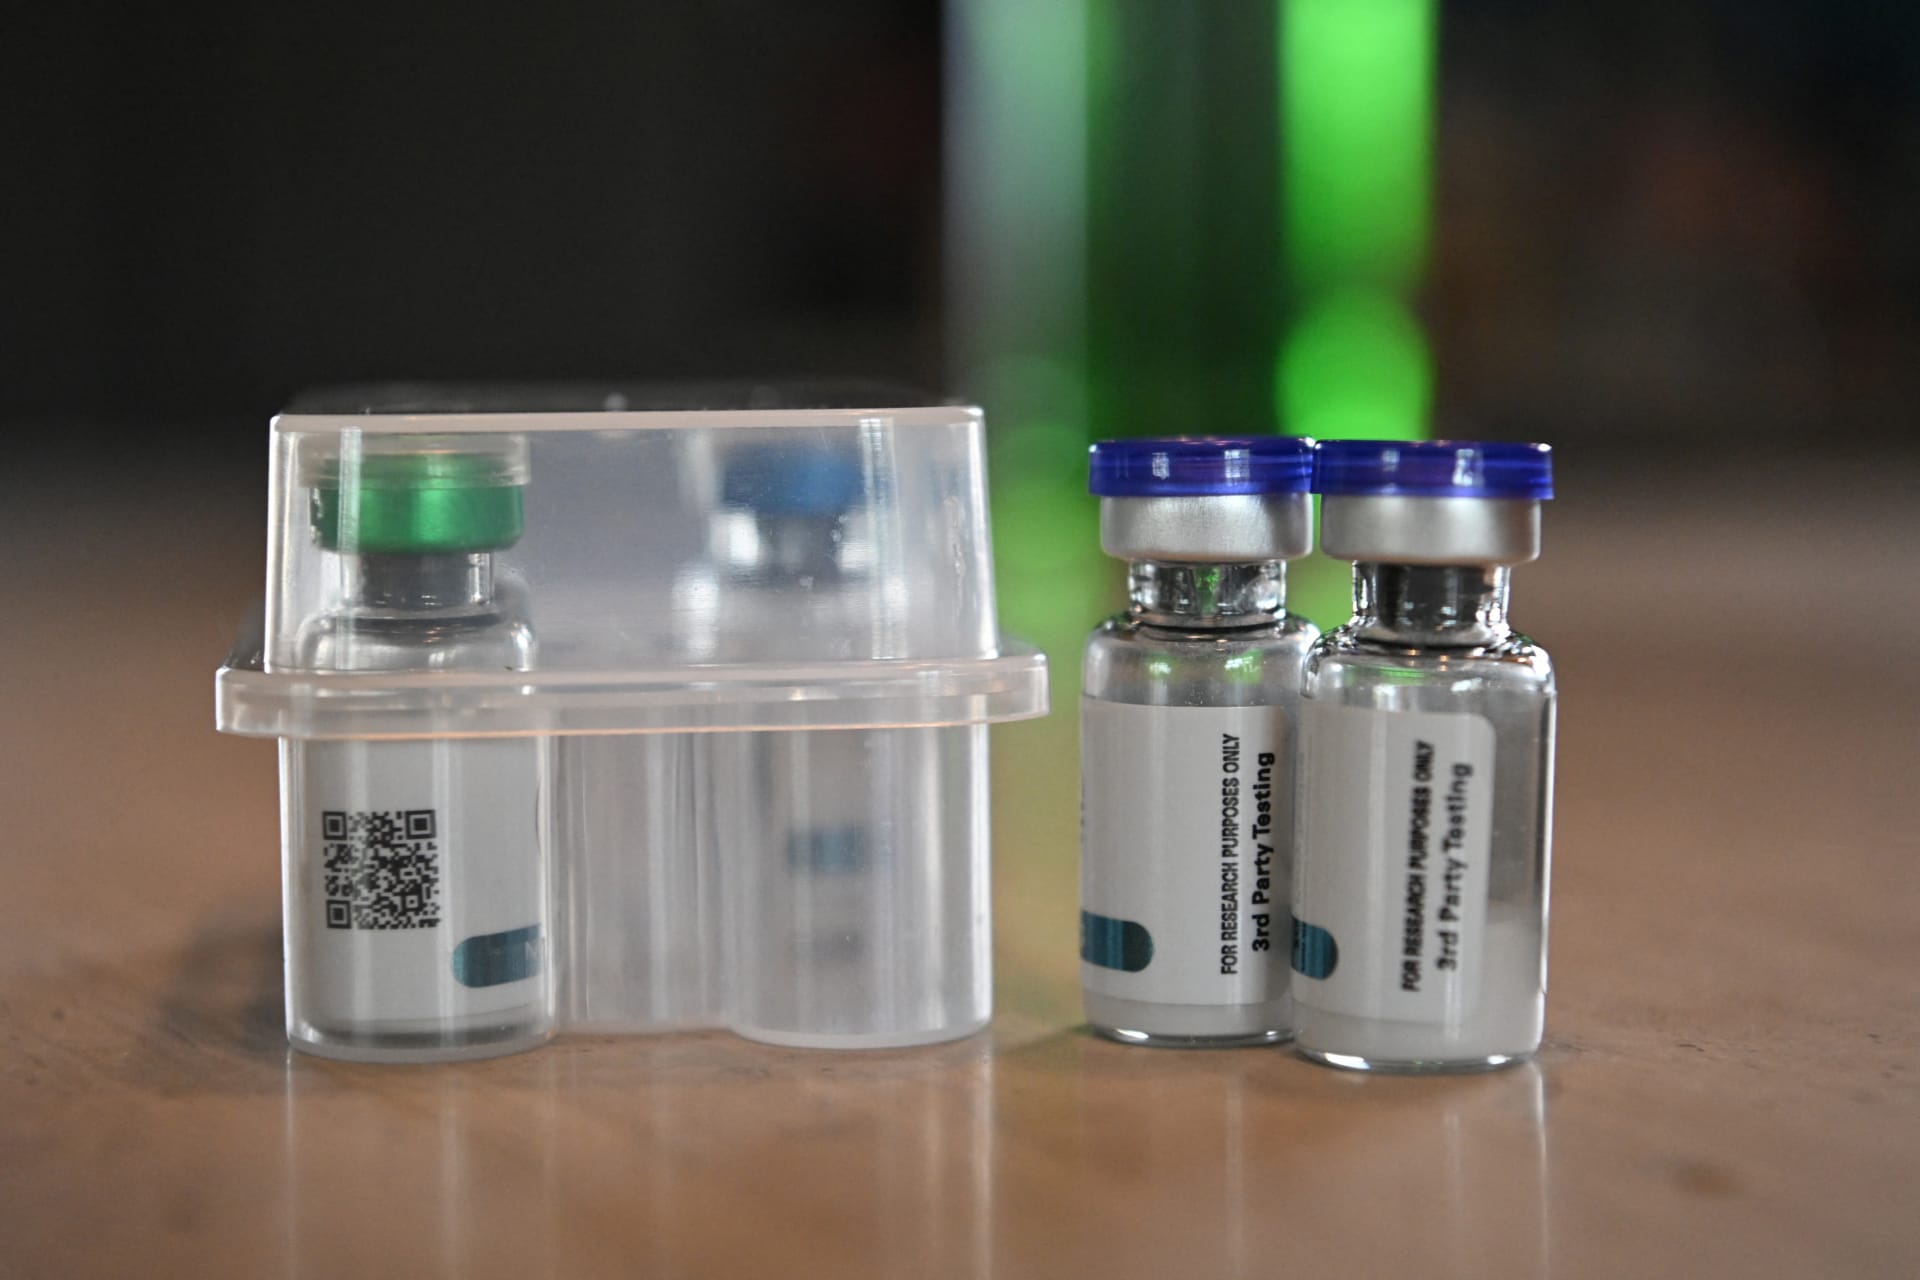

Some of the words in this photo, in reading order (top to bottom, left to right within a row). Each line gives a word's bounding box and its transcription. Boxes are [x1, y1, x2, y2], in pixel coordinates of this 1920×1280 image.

[1222, 733, 1240, 773] ONLY
[1413, 739, 1434, 782] ONLY
[1222, 778, 1239, 857] PURPOSES
[1252, 752, 1275, 840] Testing
[1440, 762, 1473, 853] Testing
[1407, 787, 1431, 870] PURPOSES
[1221, 863, 1238, 941] RESEARCH
[1252, 843, 1274, 905] Party
[1438, 857, 1468, 922] Party
[1252, 915, 1270, 952] 3rd
[1402, 874, 1426, 957] RESEARCH
[1221, 945, 1238, 975] FOR
[1401, 960, 1421, 992] FOR
[1436, 931, 1458, 972] 3rd
